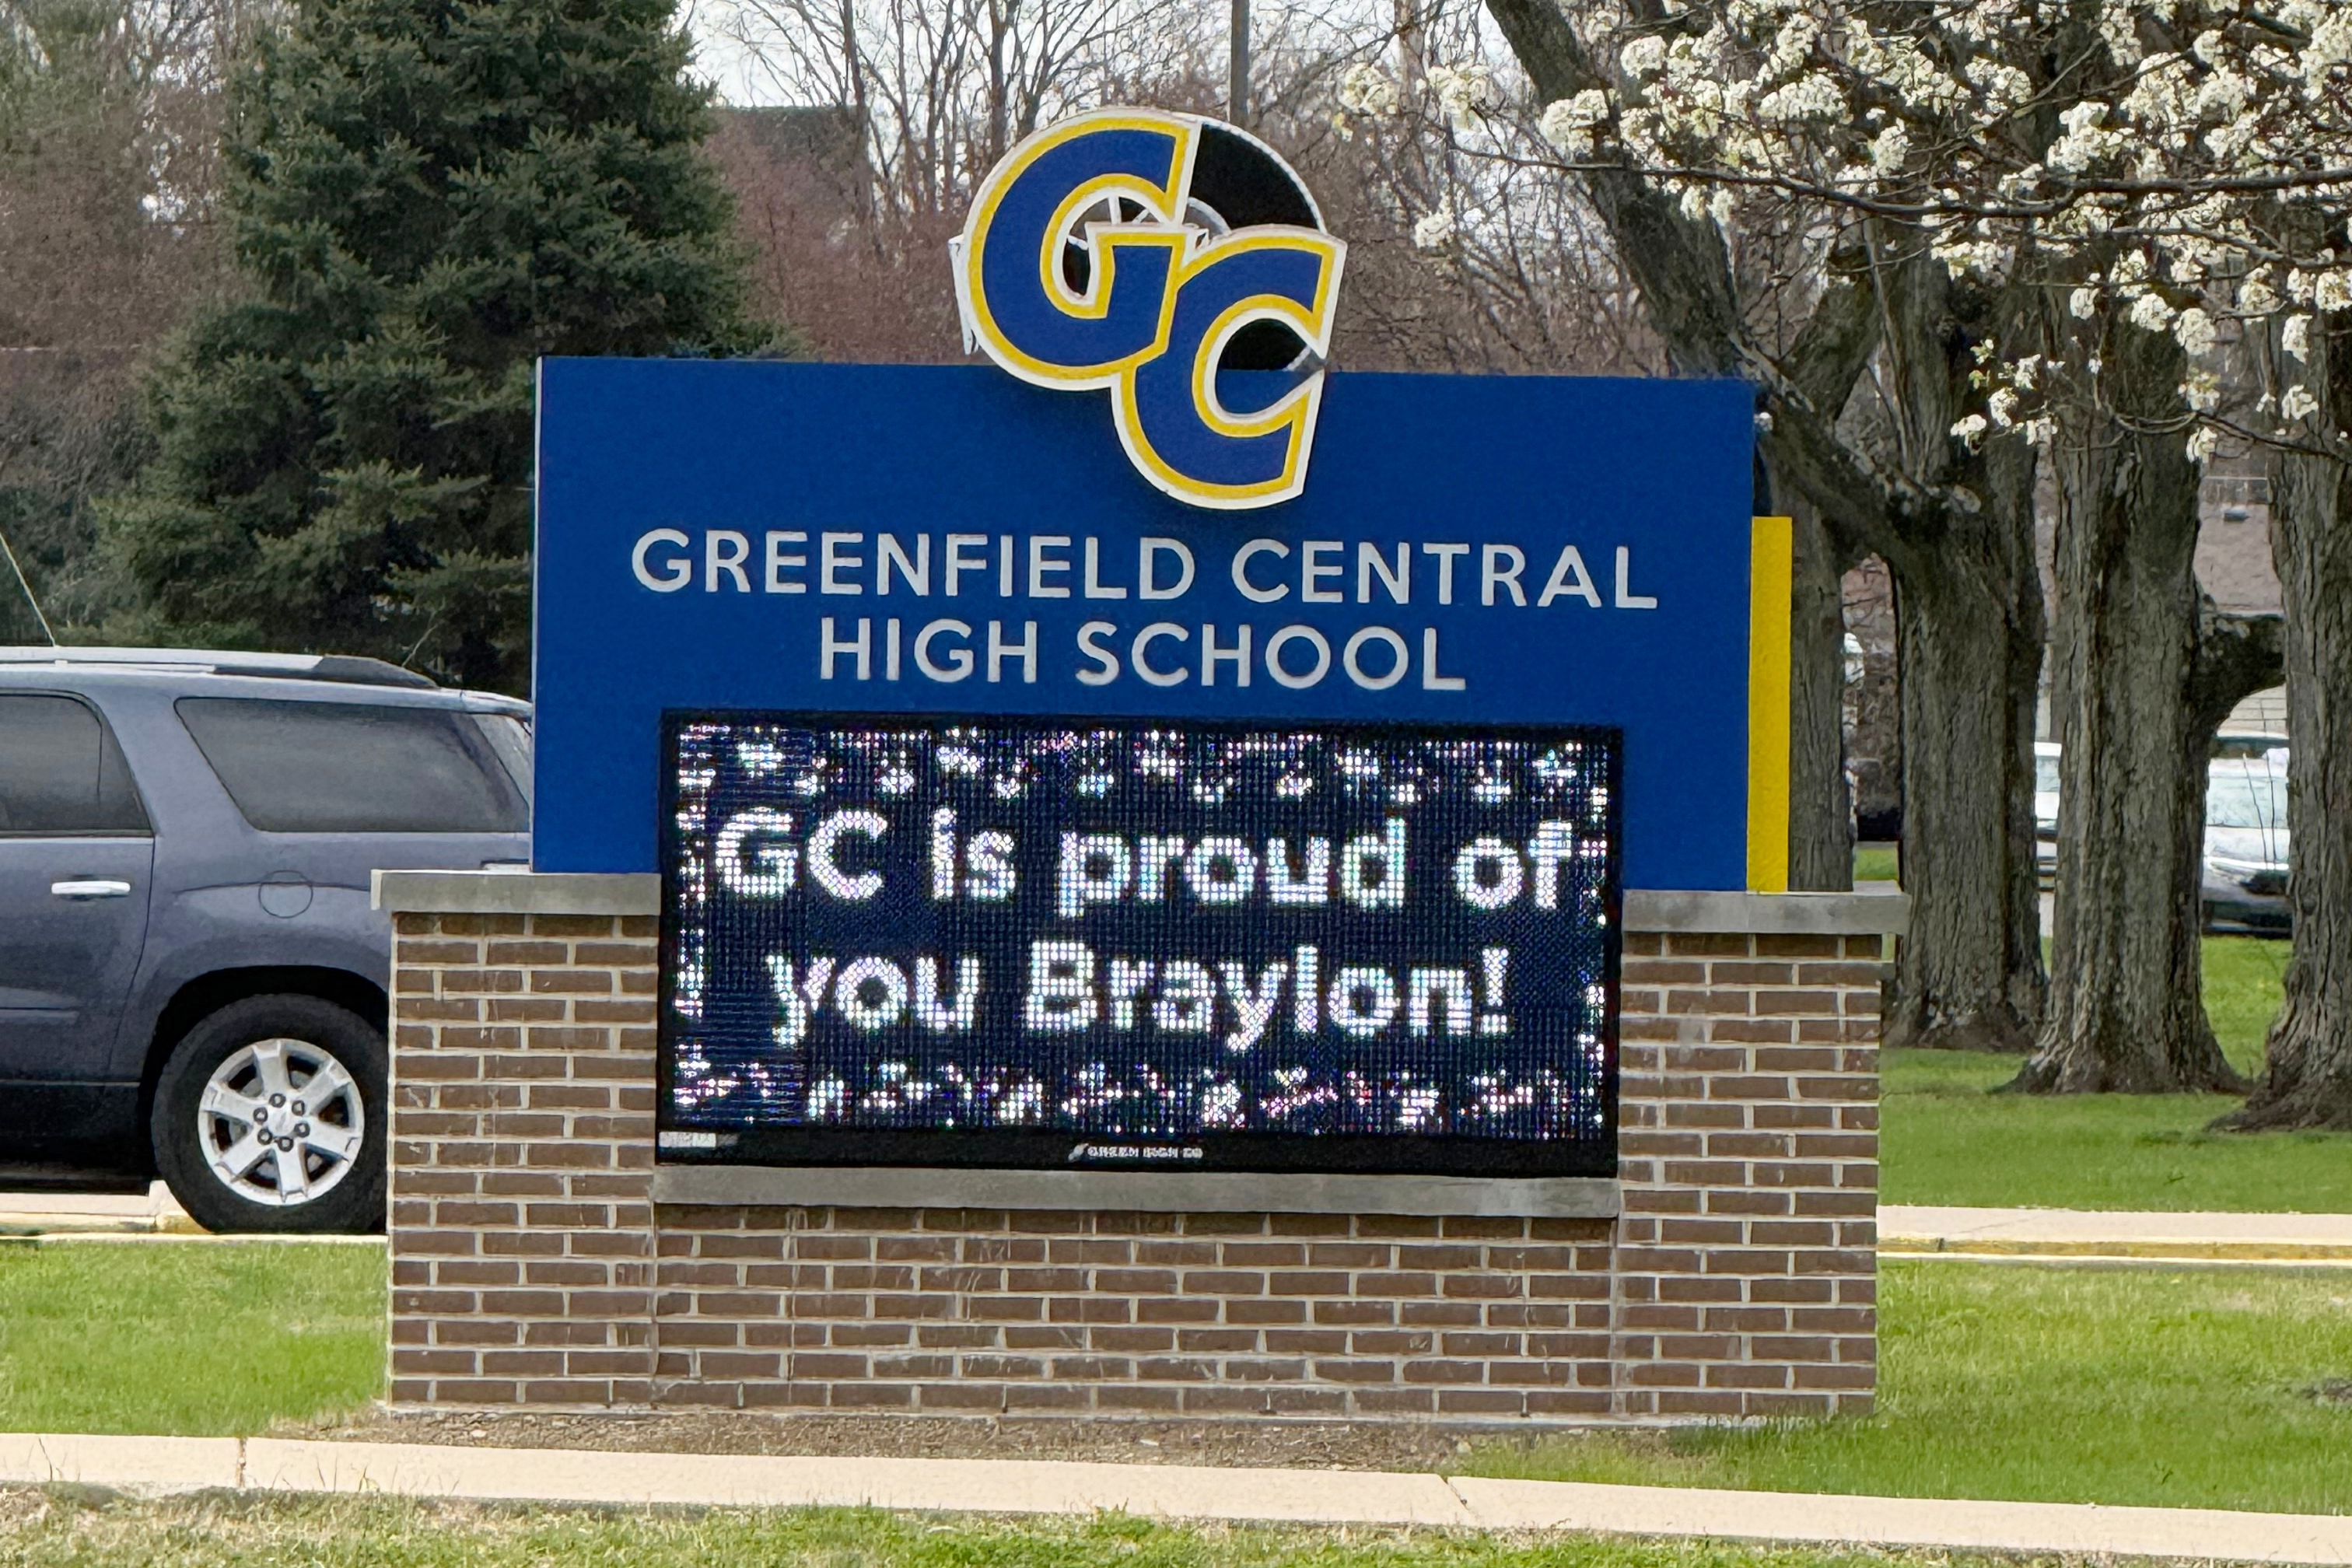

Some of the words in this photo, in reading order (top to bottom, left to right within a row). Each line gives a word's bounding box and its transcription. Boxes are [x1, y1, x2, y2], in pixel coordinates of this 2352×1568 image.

[963, 107, 1348, 510] GC
[631, 527, 1195, 601] GREENFIELD
[1230, 537, 1658, 609] CENTRAL
[820, 617, 1038, 684] HIGH
[1075, 621, 1467, 691] SCHOOL
[715, 806, 888, 901] GC
[1059, 816, 1407, 917] proud
[1451, 821, 1573, 910] of
[765, 954, 980, 1045] you
[1026, 941, 1510, 1052] Braylon!
